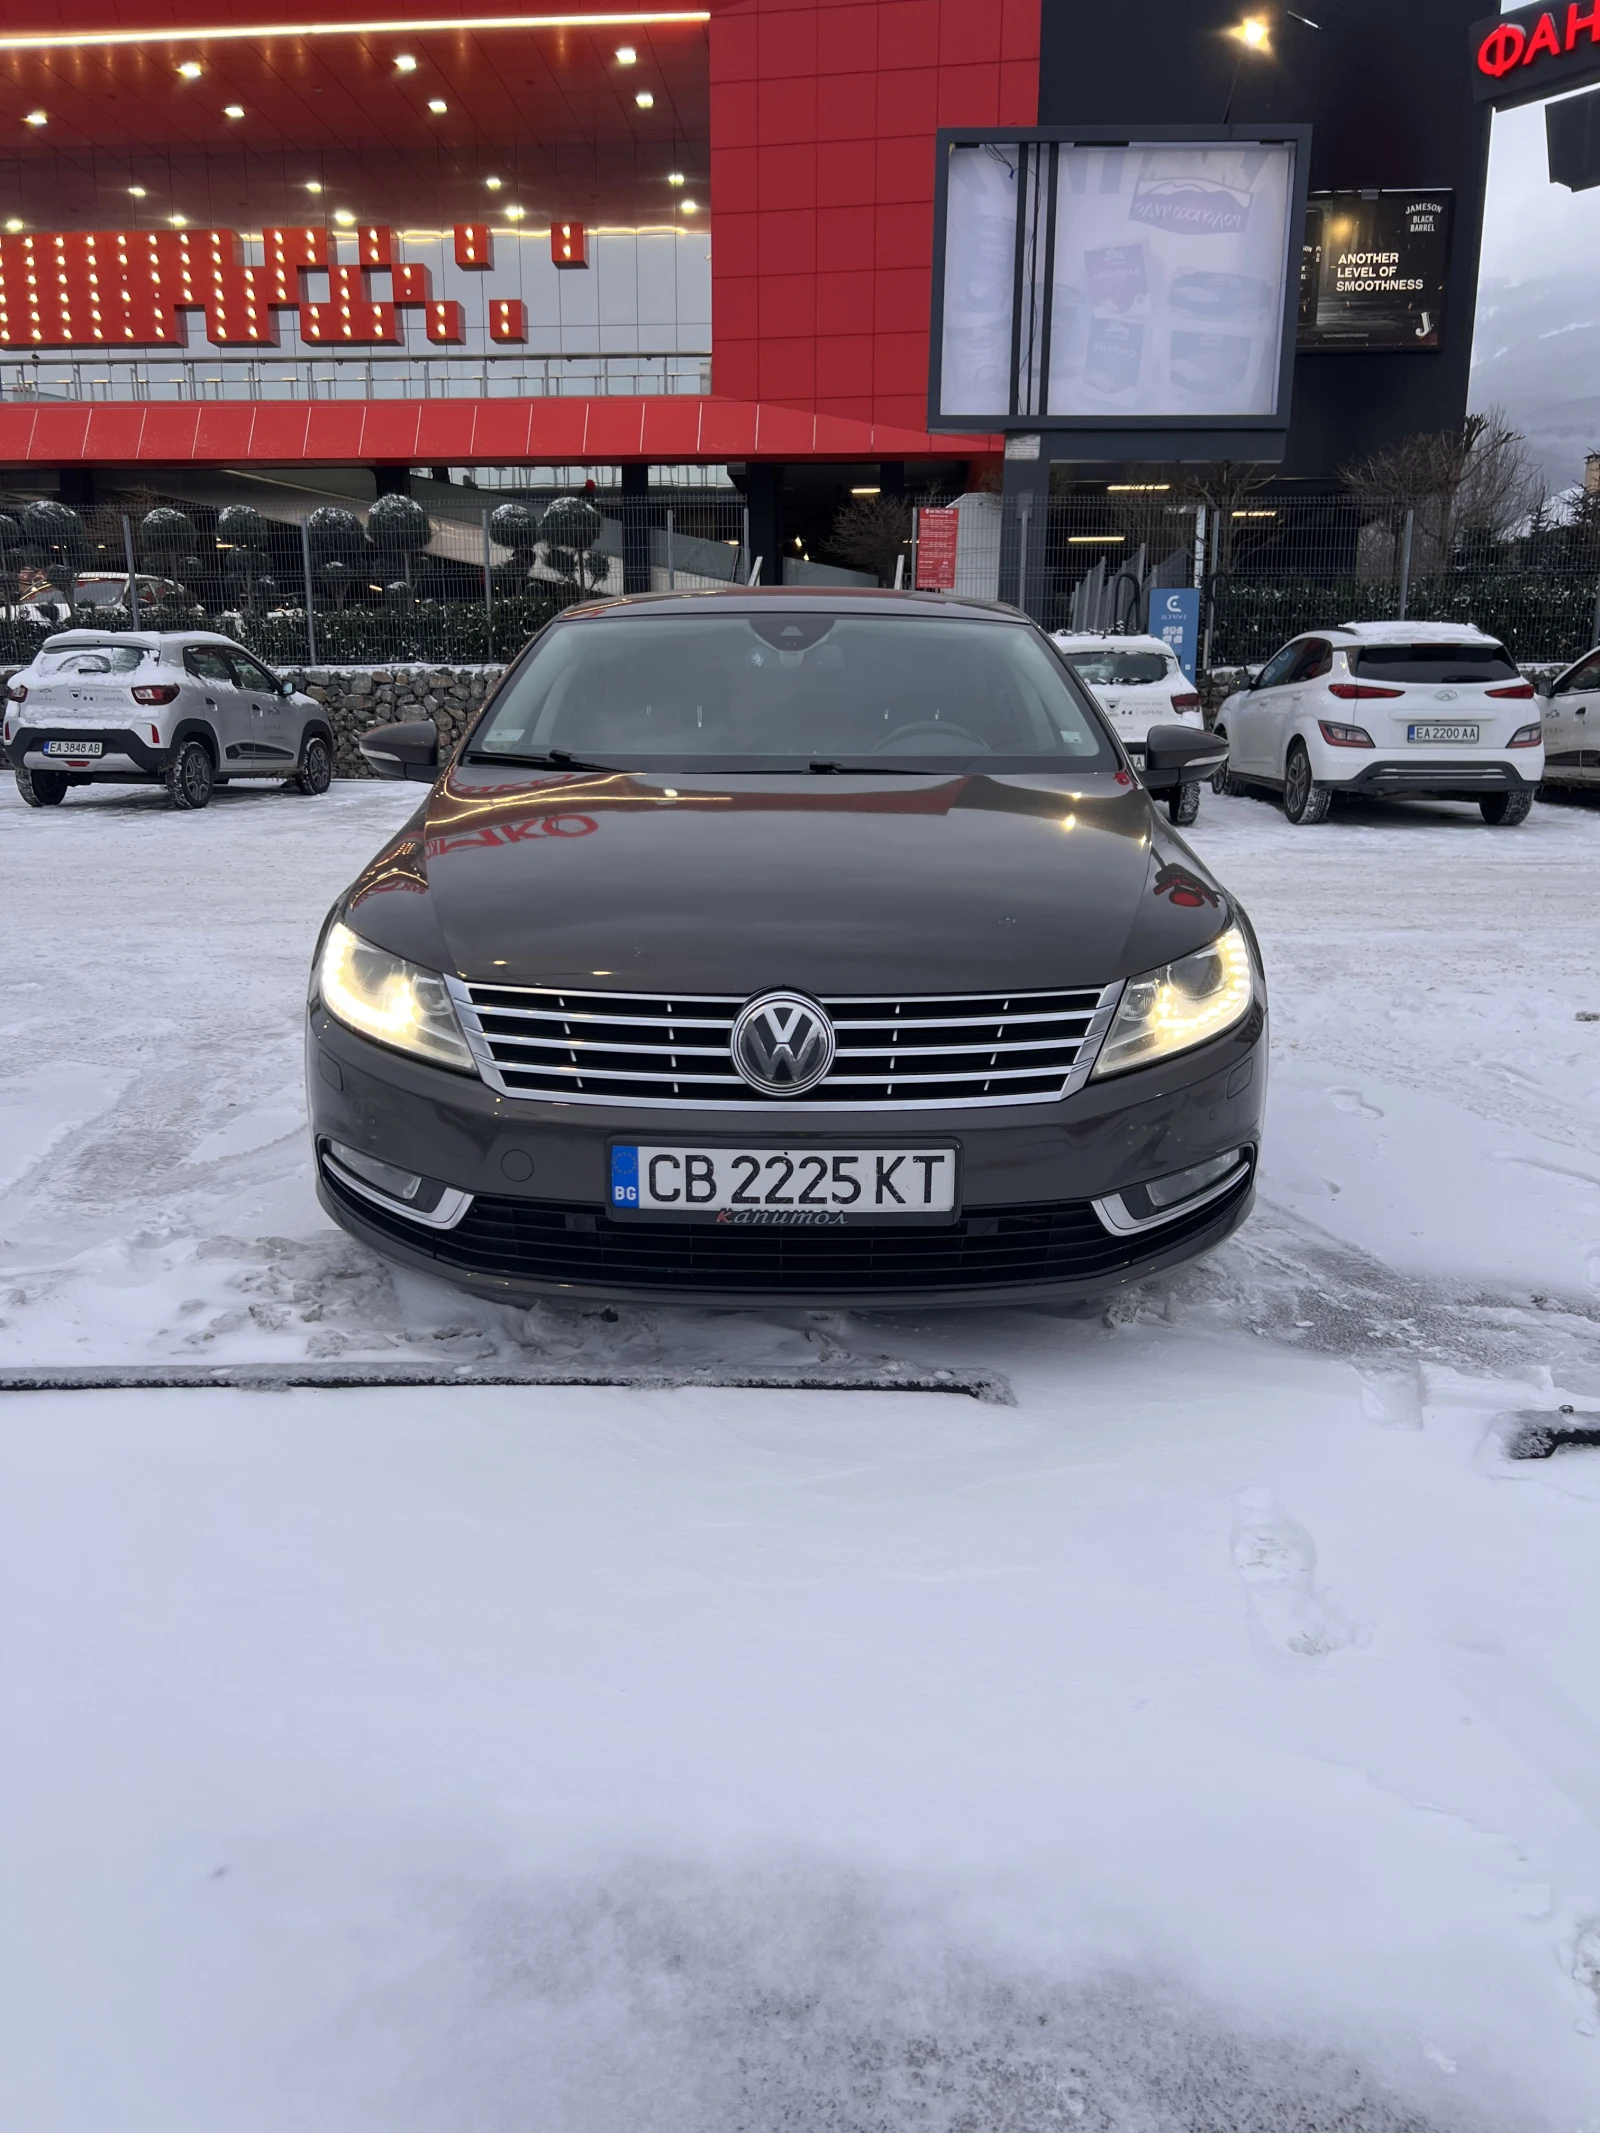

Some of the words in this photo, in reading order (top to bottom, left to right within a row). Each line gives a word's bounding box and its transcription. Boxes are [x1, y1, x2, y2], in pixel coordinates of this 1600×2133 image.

[1405, 202, 1443, 215] JAMESON
[1412, 215, 1434, 223] BLACK
[1410, 224, 1435, 233] BARREL
[1338, 252, 1399, 264] ANOTHER
[1337, 267, 1377, 278] LEVEL
[1379, 266, 1397, 277] OF
[1336, 279, 1424, 292] SMOOTHNESS
[1416, 727, 1431, 739] EA
[1433, 727, 1460, 739] 2200
[1462, 727, 1476, 739] AA
[49, 742, 62, 753] EA
[63, 743, 86, 753] 3848
[88, 743, 101, 754] AB
[648, 1154, 717, 1202] CB
[731, 1155, 862, 1204] 2225
[875, 1155, 945, 1204] KT
[614, 1186, 637, 1200] BG
